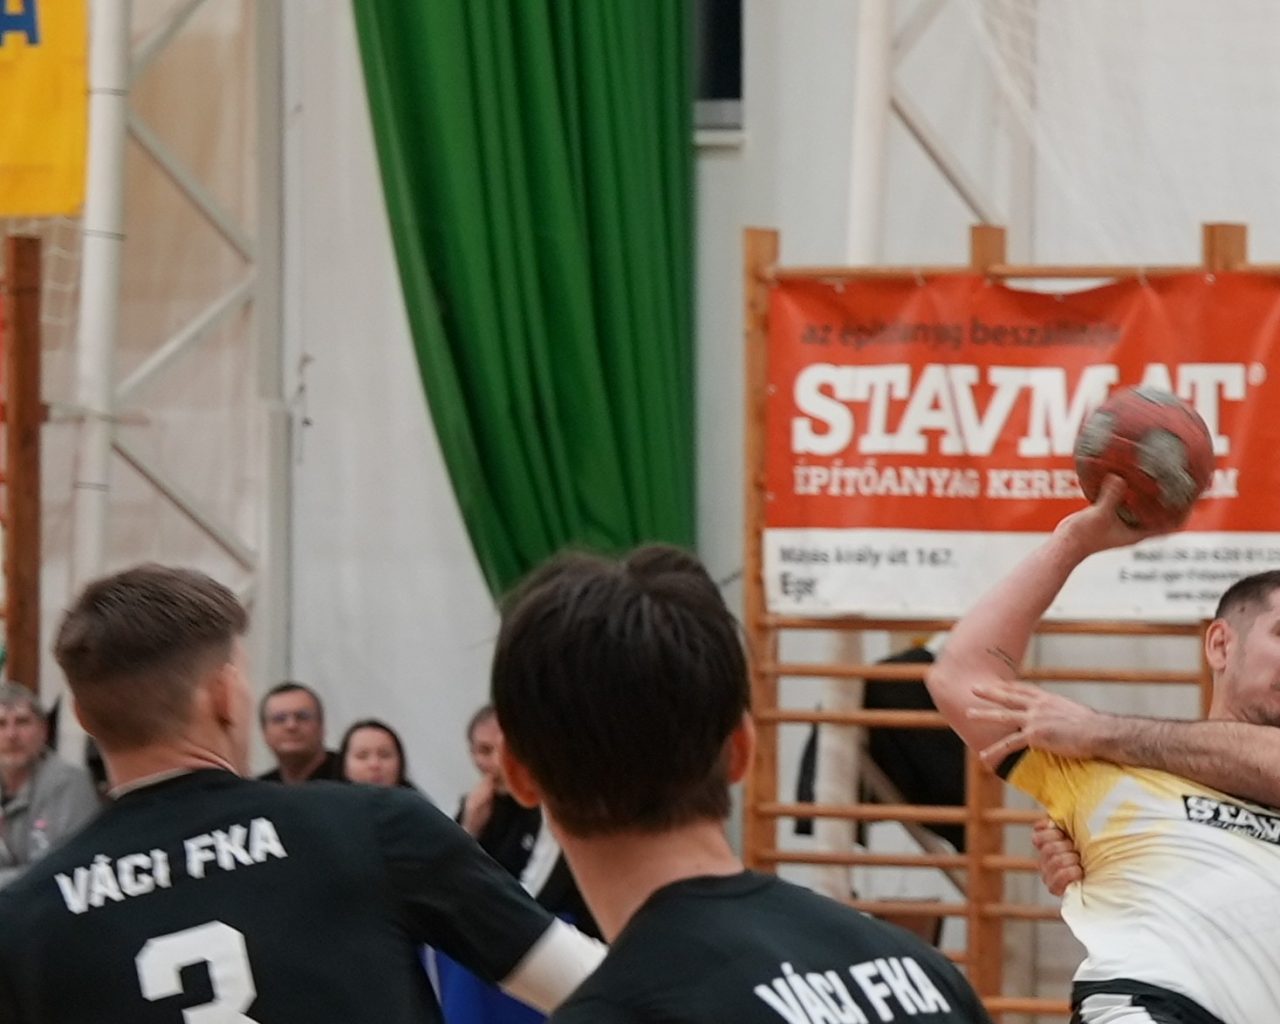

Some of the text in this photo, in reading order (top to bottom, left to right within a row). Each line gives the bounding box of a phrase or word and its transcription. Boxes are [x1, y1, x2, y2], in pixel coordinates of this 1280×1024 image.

[54, 817, 288, 914] VÁCI FKA
[849, 956, 951, 1022] FKA
